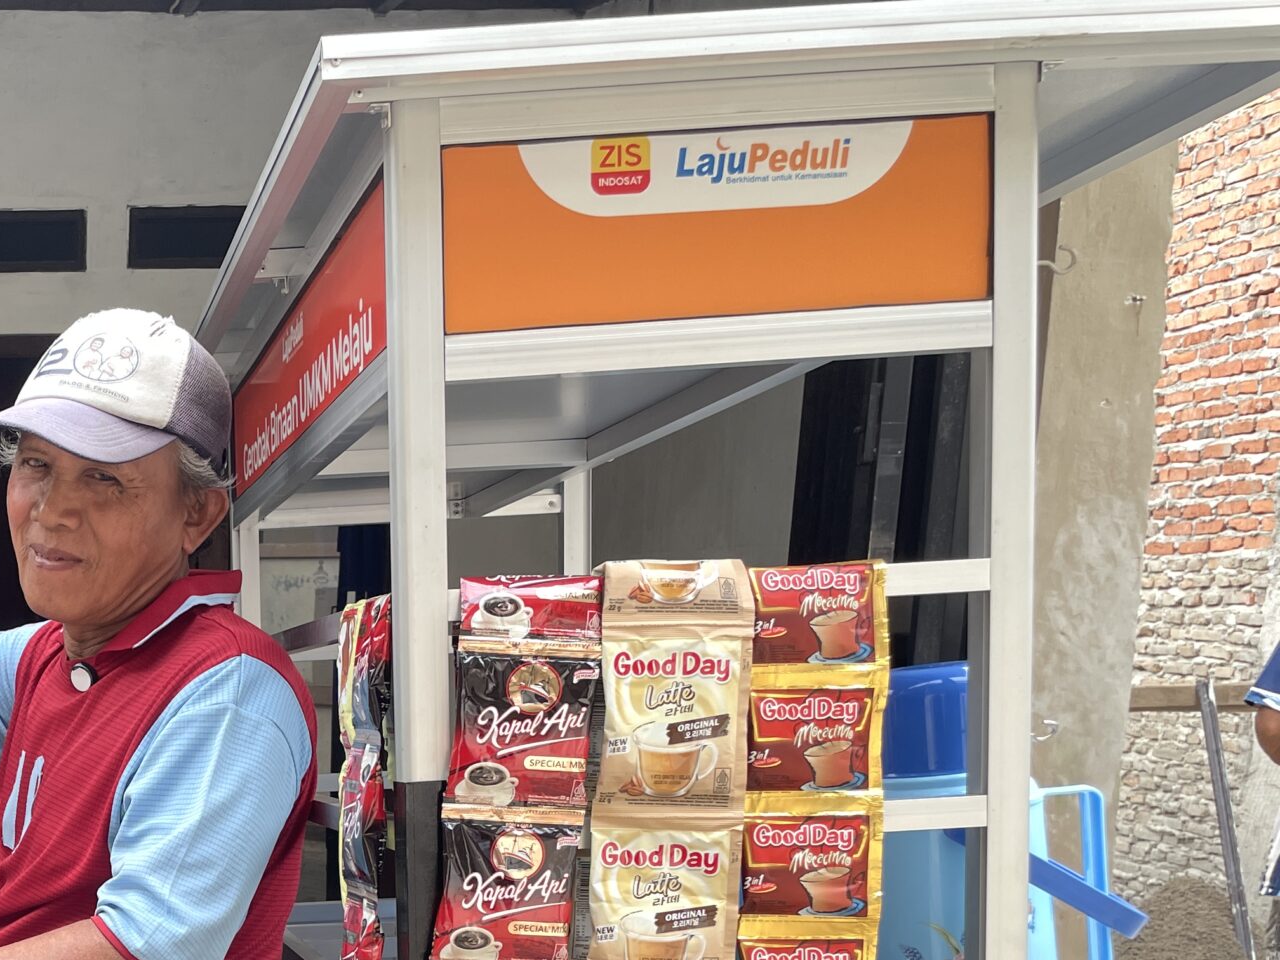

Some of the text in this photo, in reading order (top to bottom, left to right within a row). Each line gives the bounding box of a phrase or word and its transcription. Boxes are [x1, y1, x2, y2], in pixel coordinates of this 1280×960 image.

[599, 143, 642, 168] ZIS
[675, 137, 851, 184] LajuPeduli
[598, 175, 643, 188] INDOSAT
[725, 170, 848, 185] Berkhidmat untuk Kemanusiaan
[243, 298, 373, 481] Gerobak Binaan UMKM Melaju
[762, 568, 859, 594] Good Day
[613, 651, 731, 682] Good Day
[645, 681, 695, 710] Latte
[760, 697, 858, 723] Good Day
[476, 703, 588, 748] Kapal Api
[677, 718, 720, 732] ORIGINAL
[608, 738, 628, 747] NEW
[529, 758, 566, 769] SPECIAL
[754, 823, 855, 850] Good Day
[601, 841, 719, 875] Good Day
[462, 869, 569, 914] Kapal Api
[632, 872, 682, 899] Latte
[513, 923, 549, 933] SPECIAL
[664, 908, 707, 922] ORIGINAL
[596, 926, 615, 935] NEW
